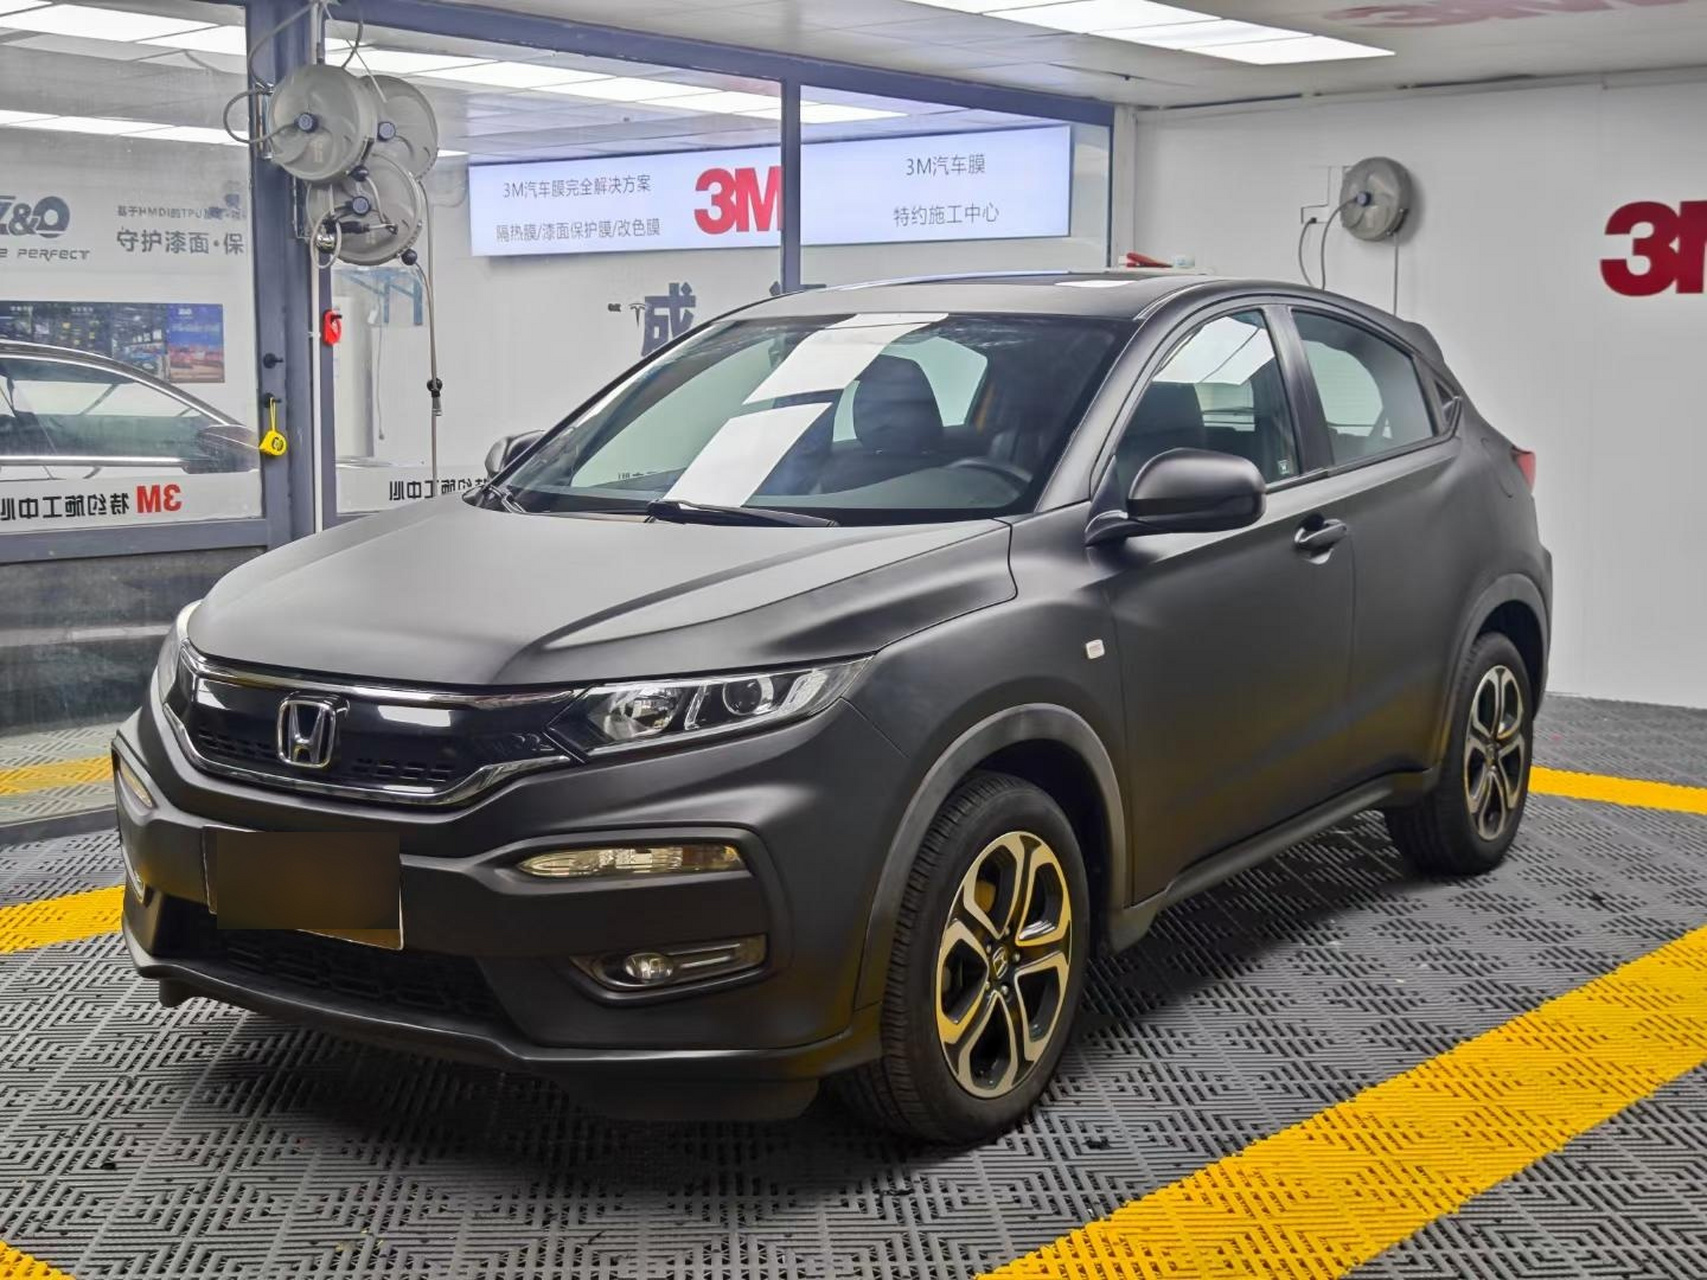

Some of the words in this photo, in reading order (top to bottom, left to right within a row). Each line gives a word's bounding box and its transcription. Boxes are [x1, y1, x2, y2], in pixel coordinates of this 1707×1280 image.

[905, 153, 986, 177] 3M汽车膜
[503, 174, 652, 199] 3M汽车膜完全解决方案
[694, 165, 784, 234] 3M
[893, 201, 1000, 227] 特约施工中心
